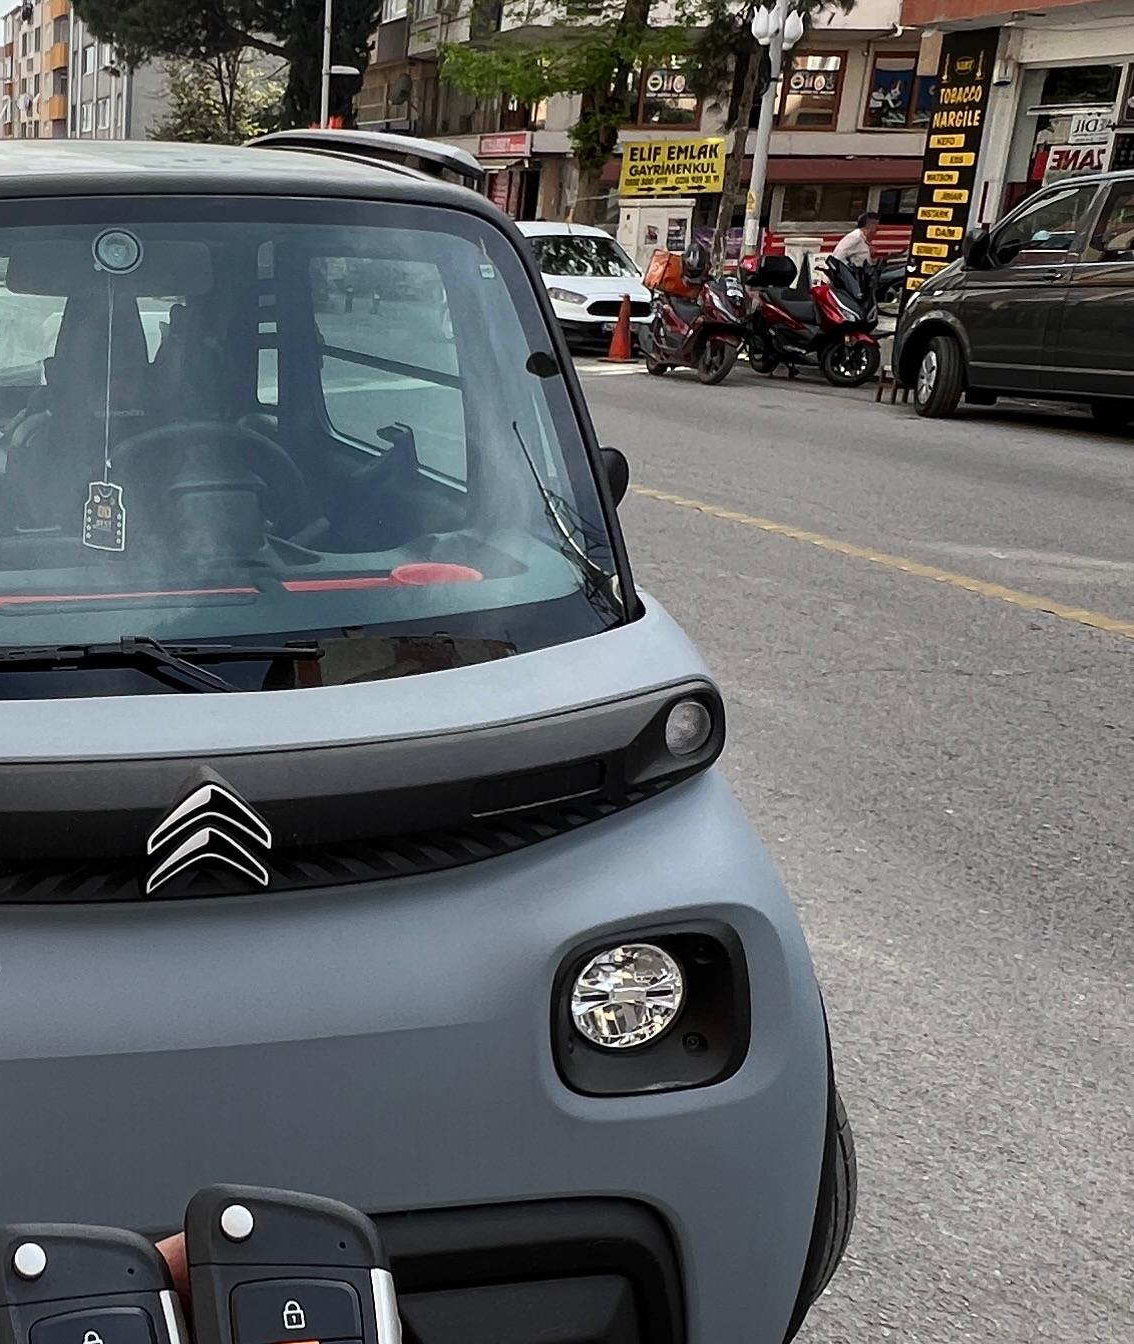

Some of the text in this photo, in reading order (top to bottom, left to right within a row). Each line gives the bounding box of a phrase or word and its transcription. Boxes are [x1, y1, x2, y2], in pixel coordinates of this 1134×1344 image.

[939, 85, 983, 104] TOBACCO
[629, 143, 721, 162] ELİF EMLAK
[629, 162, 716, 177] GAYRİMENKUL
